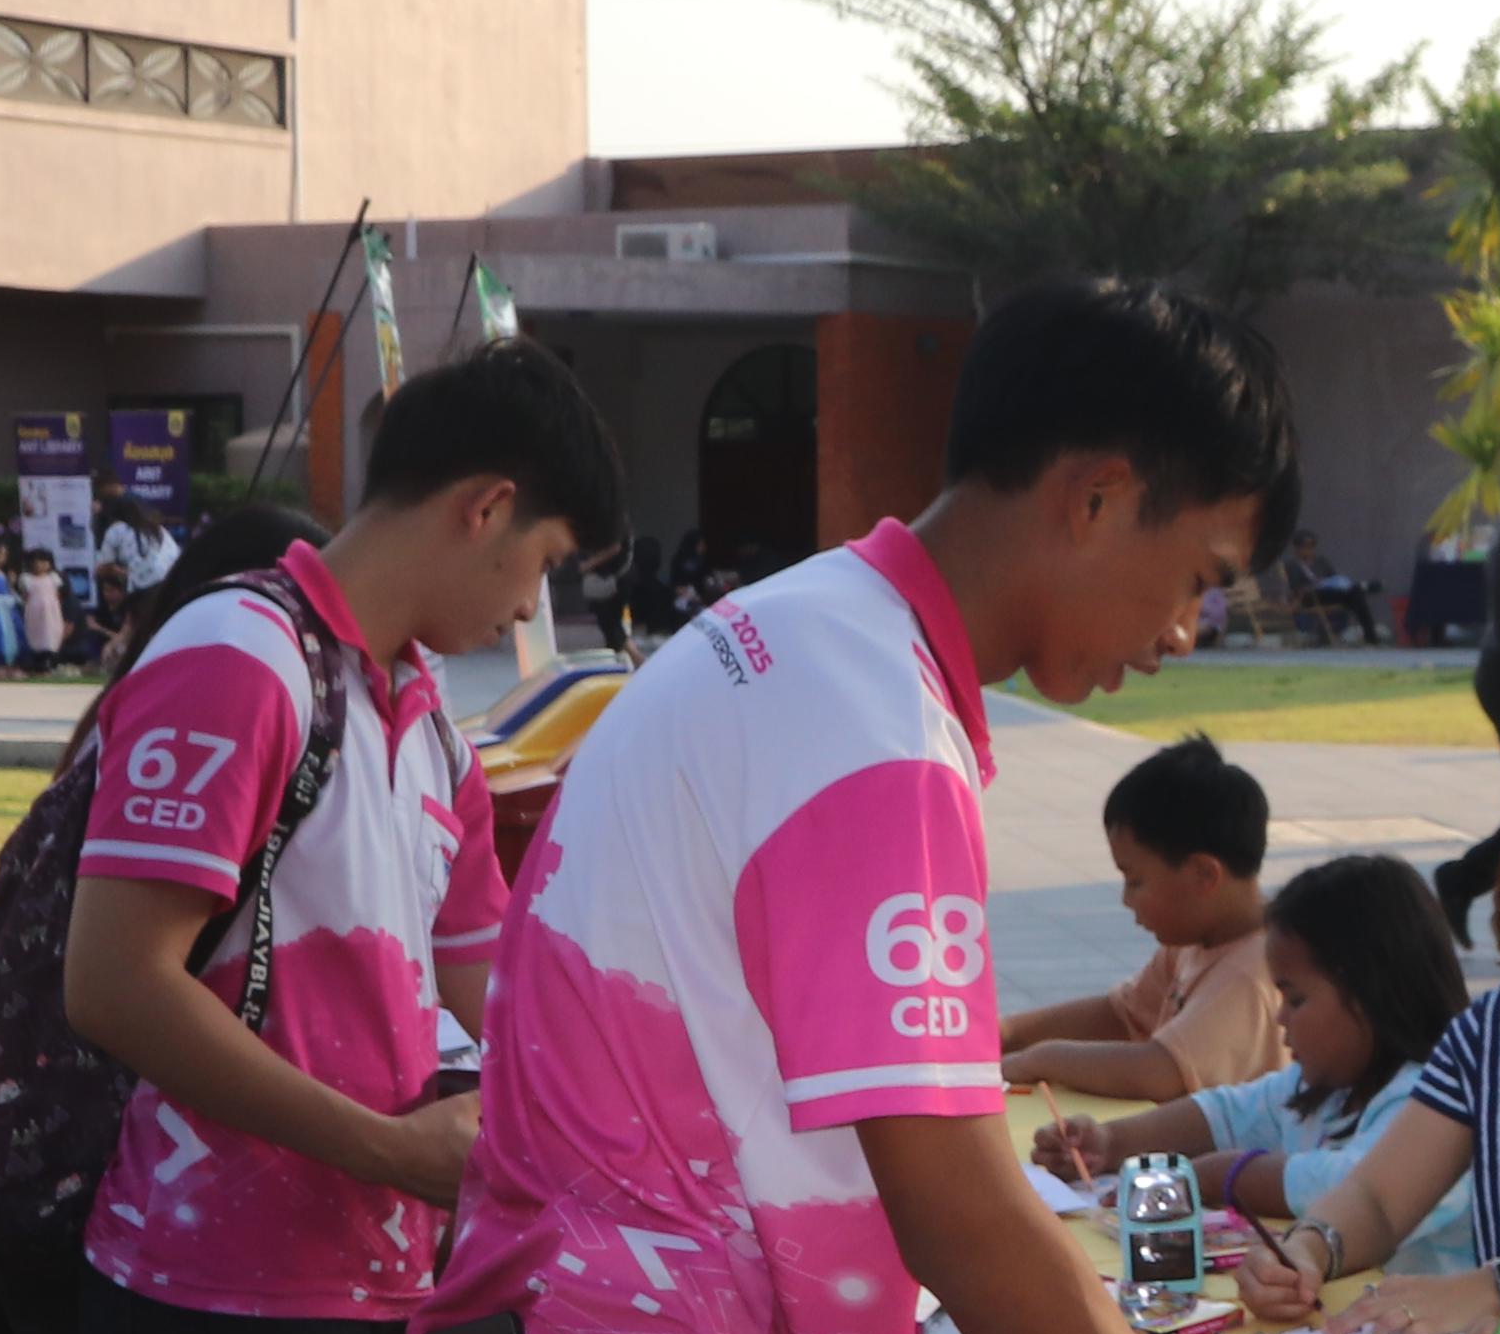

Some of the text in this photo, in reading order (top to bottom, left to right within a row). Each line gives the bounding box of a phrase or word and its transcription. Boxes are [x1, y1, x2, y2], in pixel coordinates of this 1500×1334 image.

[731, 613, 774, 675] 2025
[126, 727, 237, 795] 67
[123, 795, 206, 831] CED
[865, 892, 985, 987] 68
[890, 995, 969, 1037] CED
